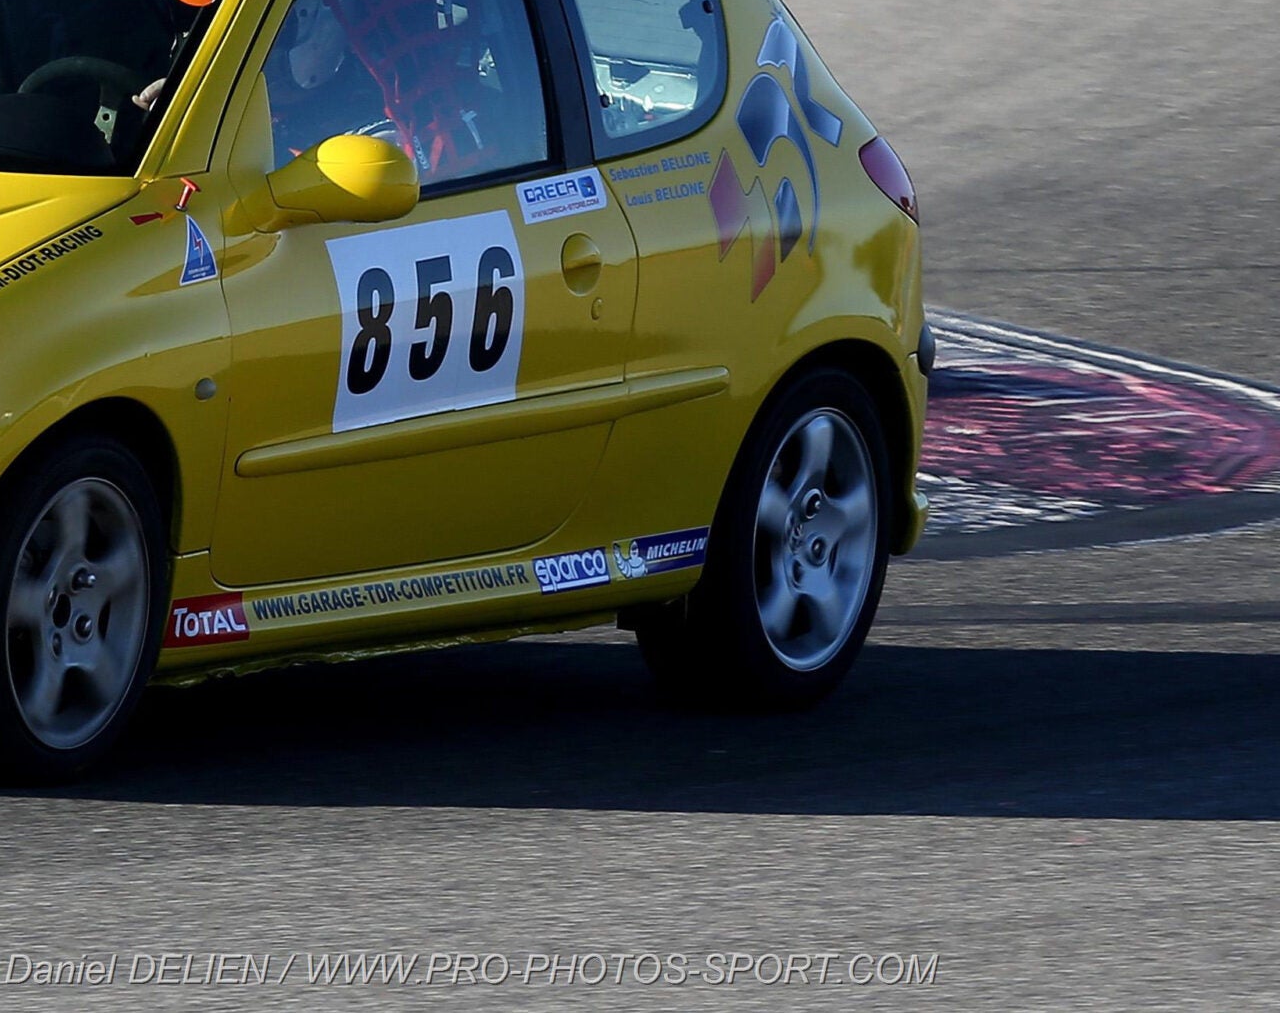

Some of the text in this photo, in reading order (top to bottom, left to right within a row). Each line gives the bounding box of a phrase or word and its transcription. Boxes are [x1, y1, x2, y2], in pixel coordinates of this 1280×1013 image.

[609, 151, 711, 182] Sebastien BELLONE
[524, 179, 579, 203] ORECA
[624, 181, 705, 206] Louis BELLONE
[346, 245, 516, 395] 856
[646, 537, 708, 560] MICHELIN
[535, 549, 607, 591] sparco
[252, 563, 529, 620] WWW.GARAGE-TDR-COMPETITION.FR
[173, 607, 246, 638] TOTAL
